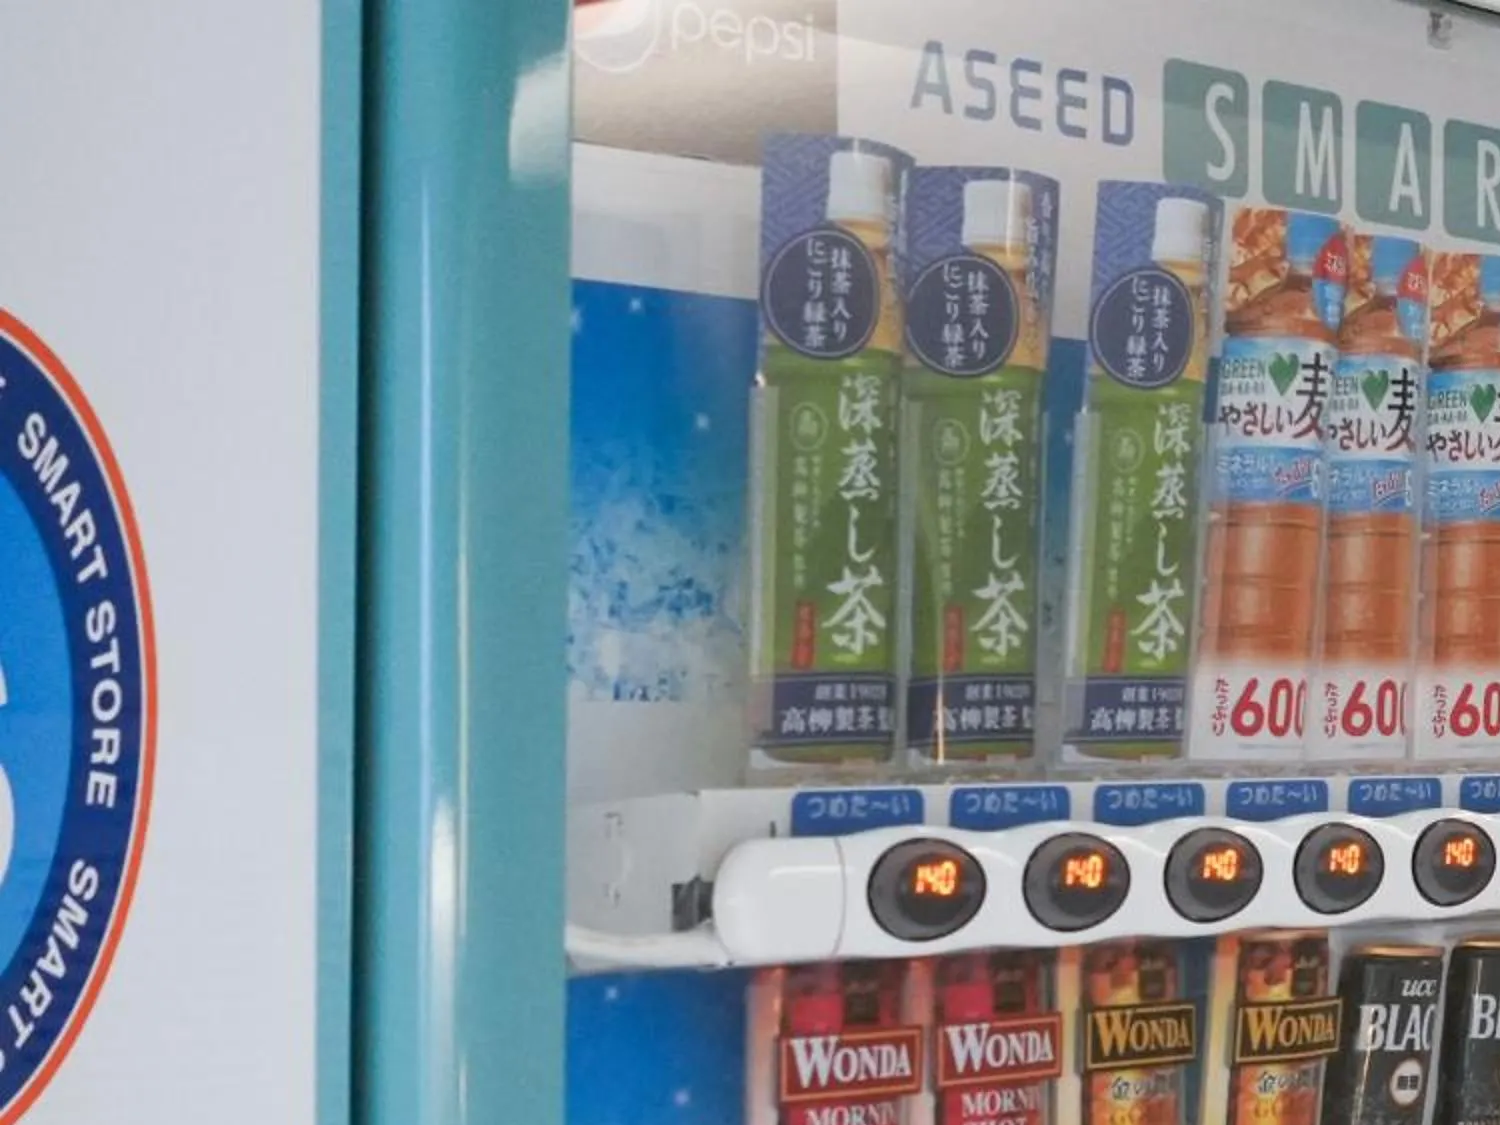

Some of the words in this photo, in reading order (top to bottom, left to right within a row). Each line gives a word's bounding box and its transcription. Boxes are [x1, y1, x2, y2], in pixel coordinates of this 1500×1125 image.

[671, 3, 816, 66] pepsi
[911, 41, 1134, 146] ASEED
[822, 374, 885, 656] 深蒸し茶
[969, 390, 1027, 657] 深蒸し茶
[1131, 402, 1191, 662] 深蒸し茶
[17, 412, 108, 584] SMART
[86, 600, 123, 808] STORE
[916, 861, 956, 895] 140
[1067, 855, 1103, 887] 140
[1204, 850, 1237, 880] 140
[1330, 845, 1360, 873] 140
[1446, 839, 1474, 866] 140
[13, 859, 99, 1052] SMART
[946, 1022, 1056, 1074] WONDA
[1094, 1009, 1192, 1057] WONDA
[1246, 1006, 1335, 1051] WONDA
[791, 1036, 912, 1087] WONDA
